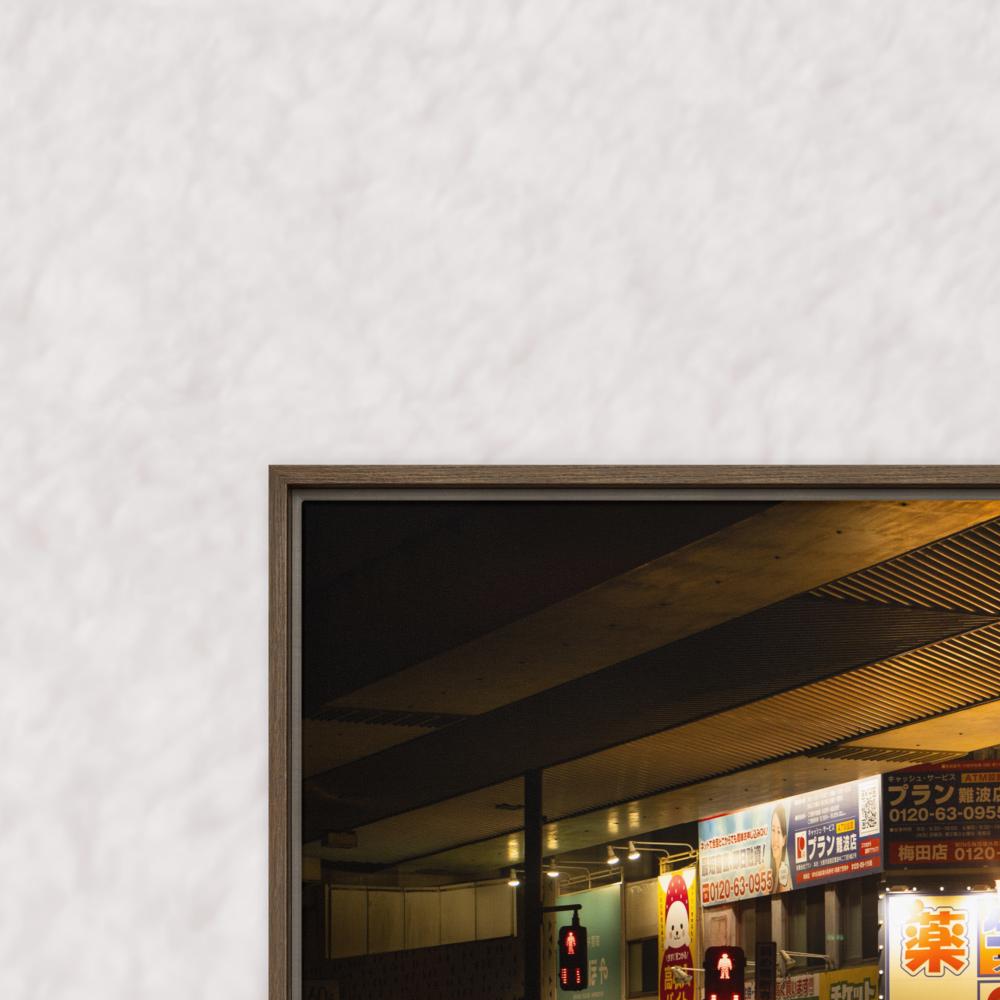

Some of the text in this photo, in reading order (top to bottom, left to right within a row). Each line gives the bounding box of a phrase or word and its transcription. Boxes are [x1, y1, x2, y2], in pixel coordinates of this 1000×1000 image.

[887, 783, 955, 807] プラン
[807, 833, 835, 861] プラン
[897, 843, 948, 862] 梅田店
[709, 869, 773, 902] 0120-63-0955
[902, 908, 968, 976] 薬
